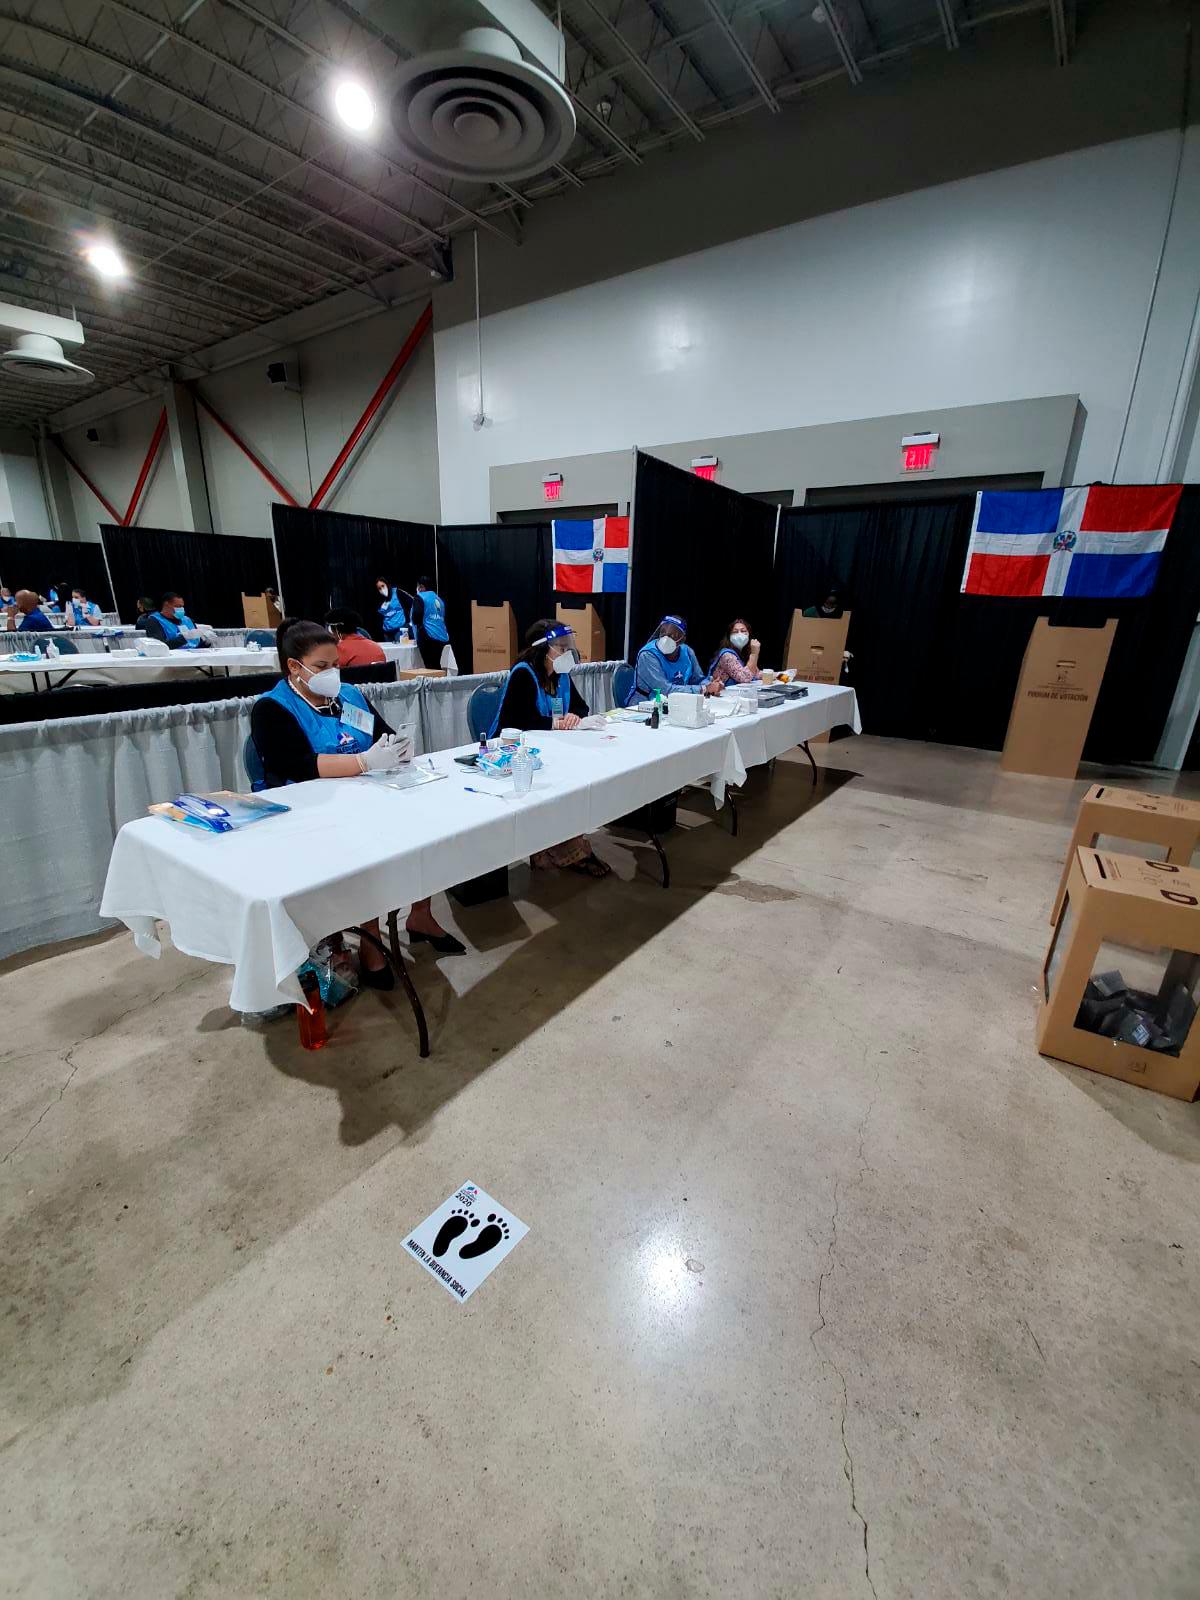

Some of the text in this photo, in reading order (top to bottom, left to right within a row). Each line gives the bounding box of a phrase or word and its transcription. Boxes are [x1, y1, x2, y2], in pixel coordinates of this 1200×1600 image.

[455, 1192, 472, 1207] 2020
[407, 1239, 468, 1298] MANTEN LA DISTANCIA SOCIAL
